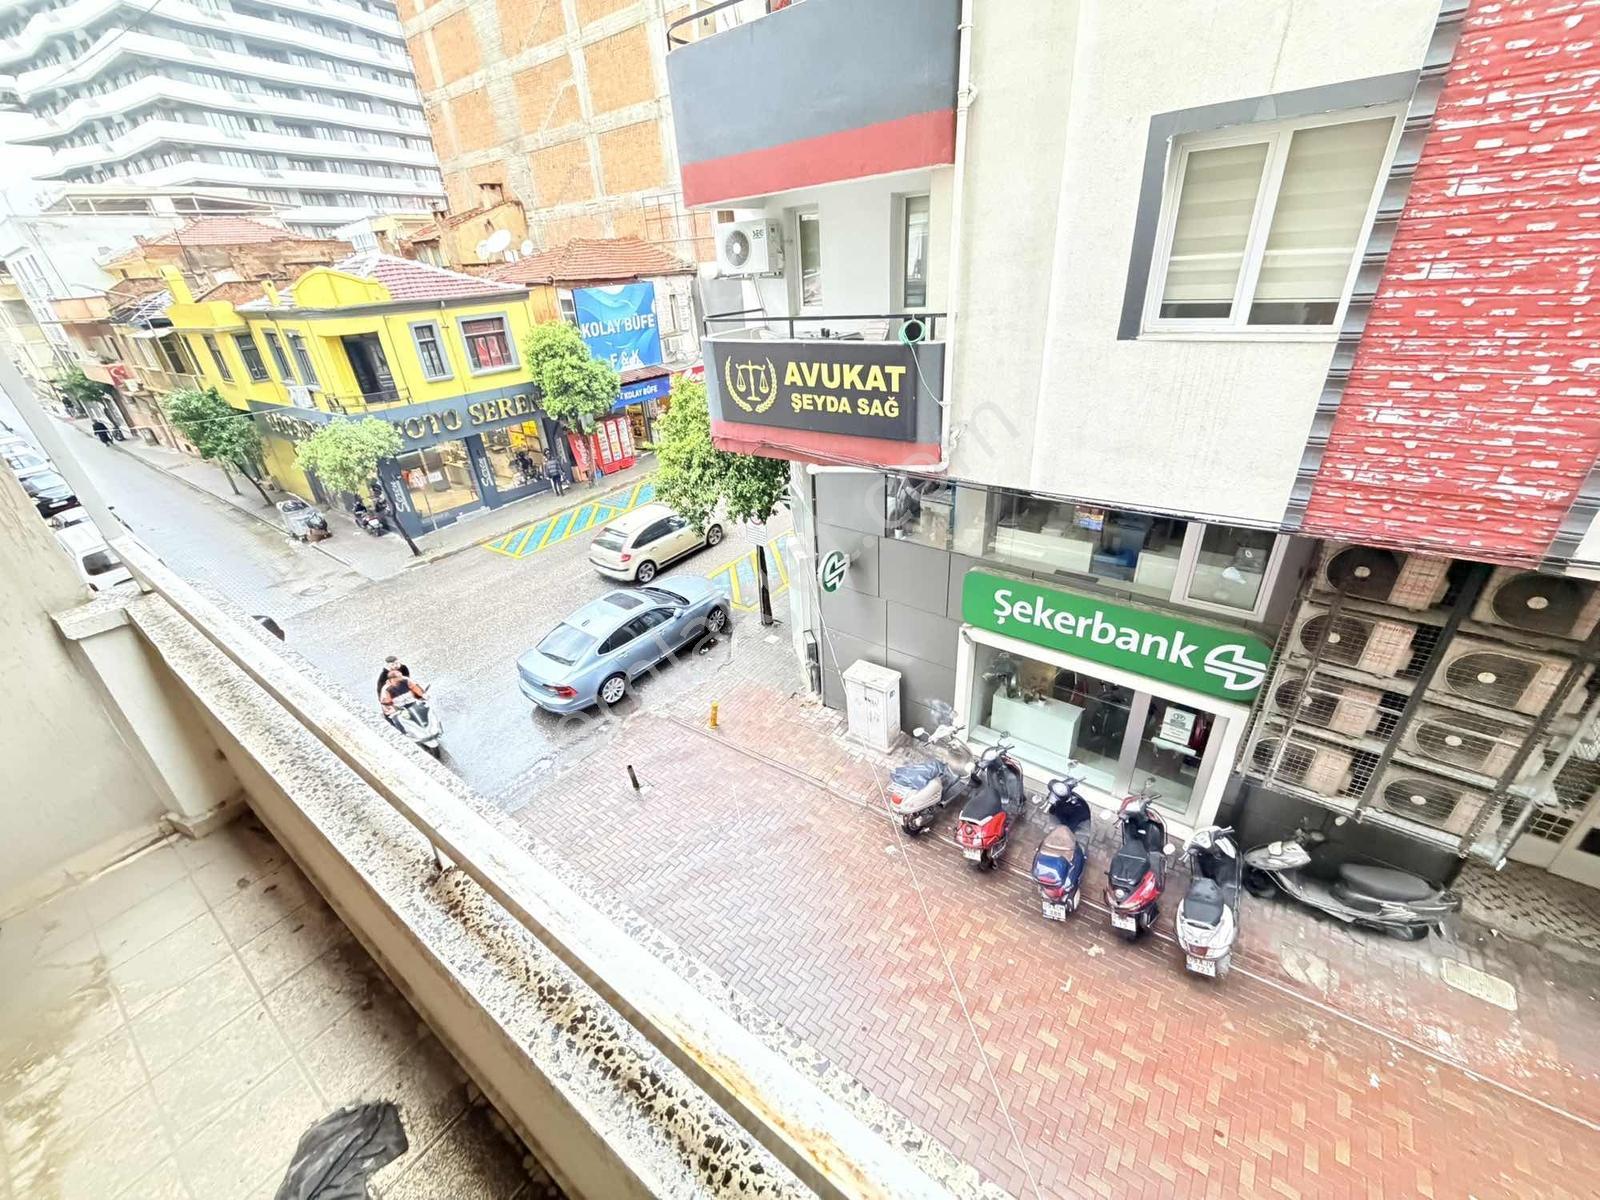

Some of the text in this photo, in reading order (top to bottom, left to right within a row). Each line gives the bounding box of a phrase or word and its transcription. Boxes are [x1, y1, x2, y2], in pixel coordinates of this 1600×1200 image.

[581, 313, 655, 339] KOLAY BÜFE
[784, 362, 906, 392] AVUKAT
[624, 389, 643, 400] KOLAY
[791, 393, 900, 418] ŞEYDA SAĞ
[398, 409, 462, 439] OTO
[993, 589, 1199, 669] Şekerbank
